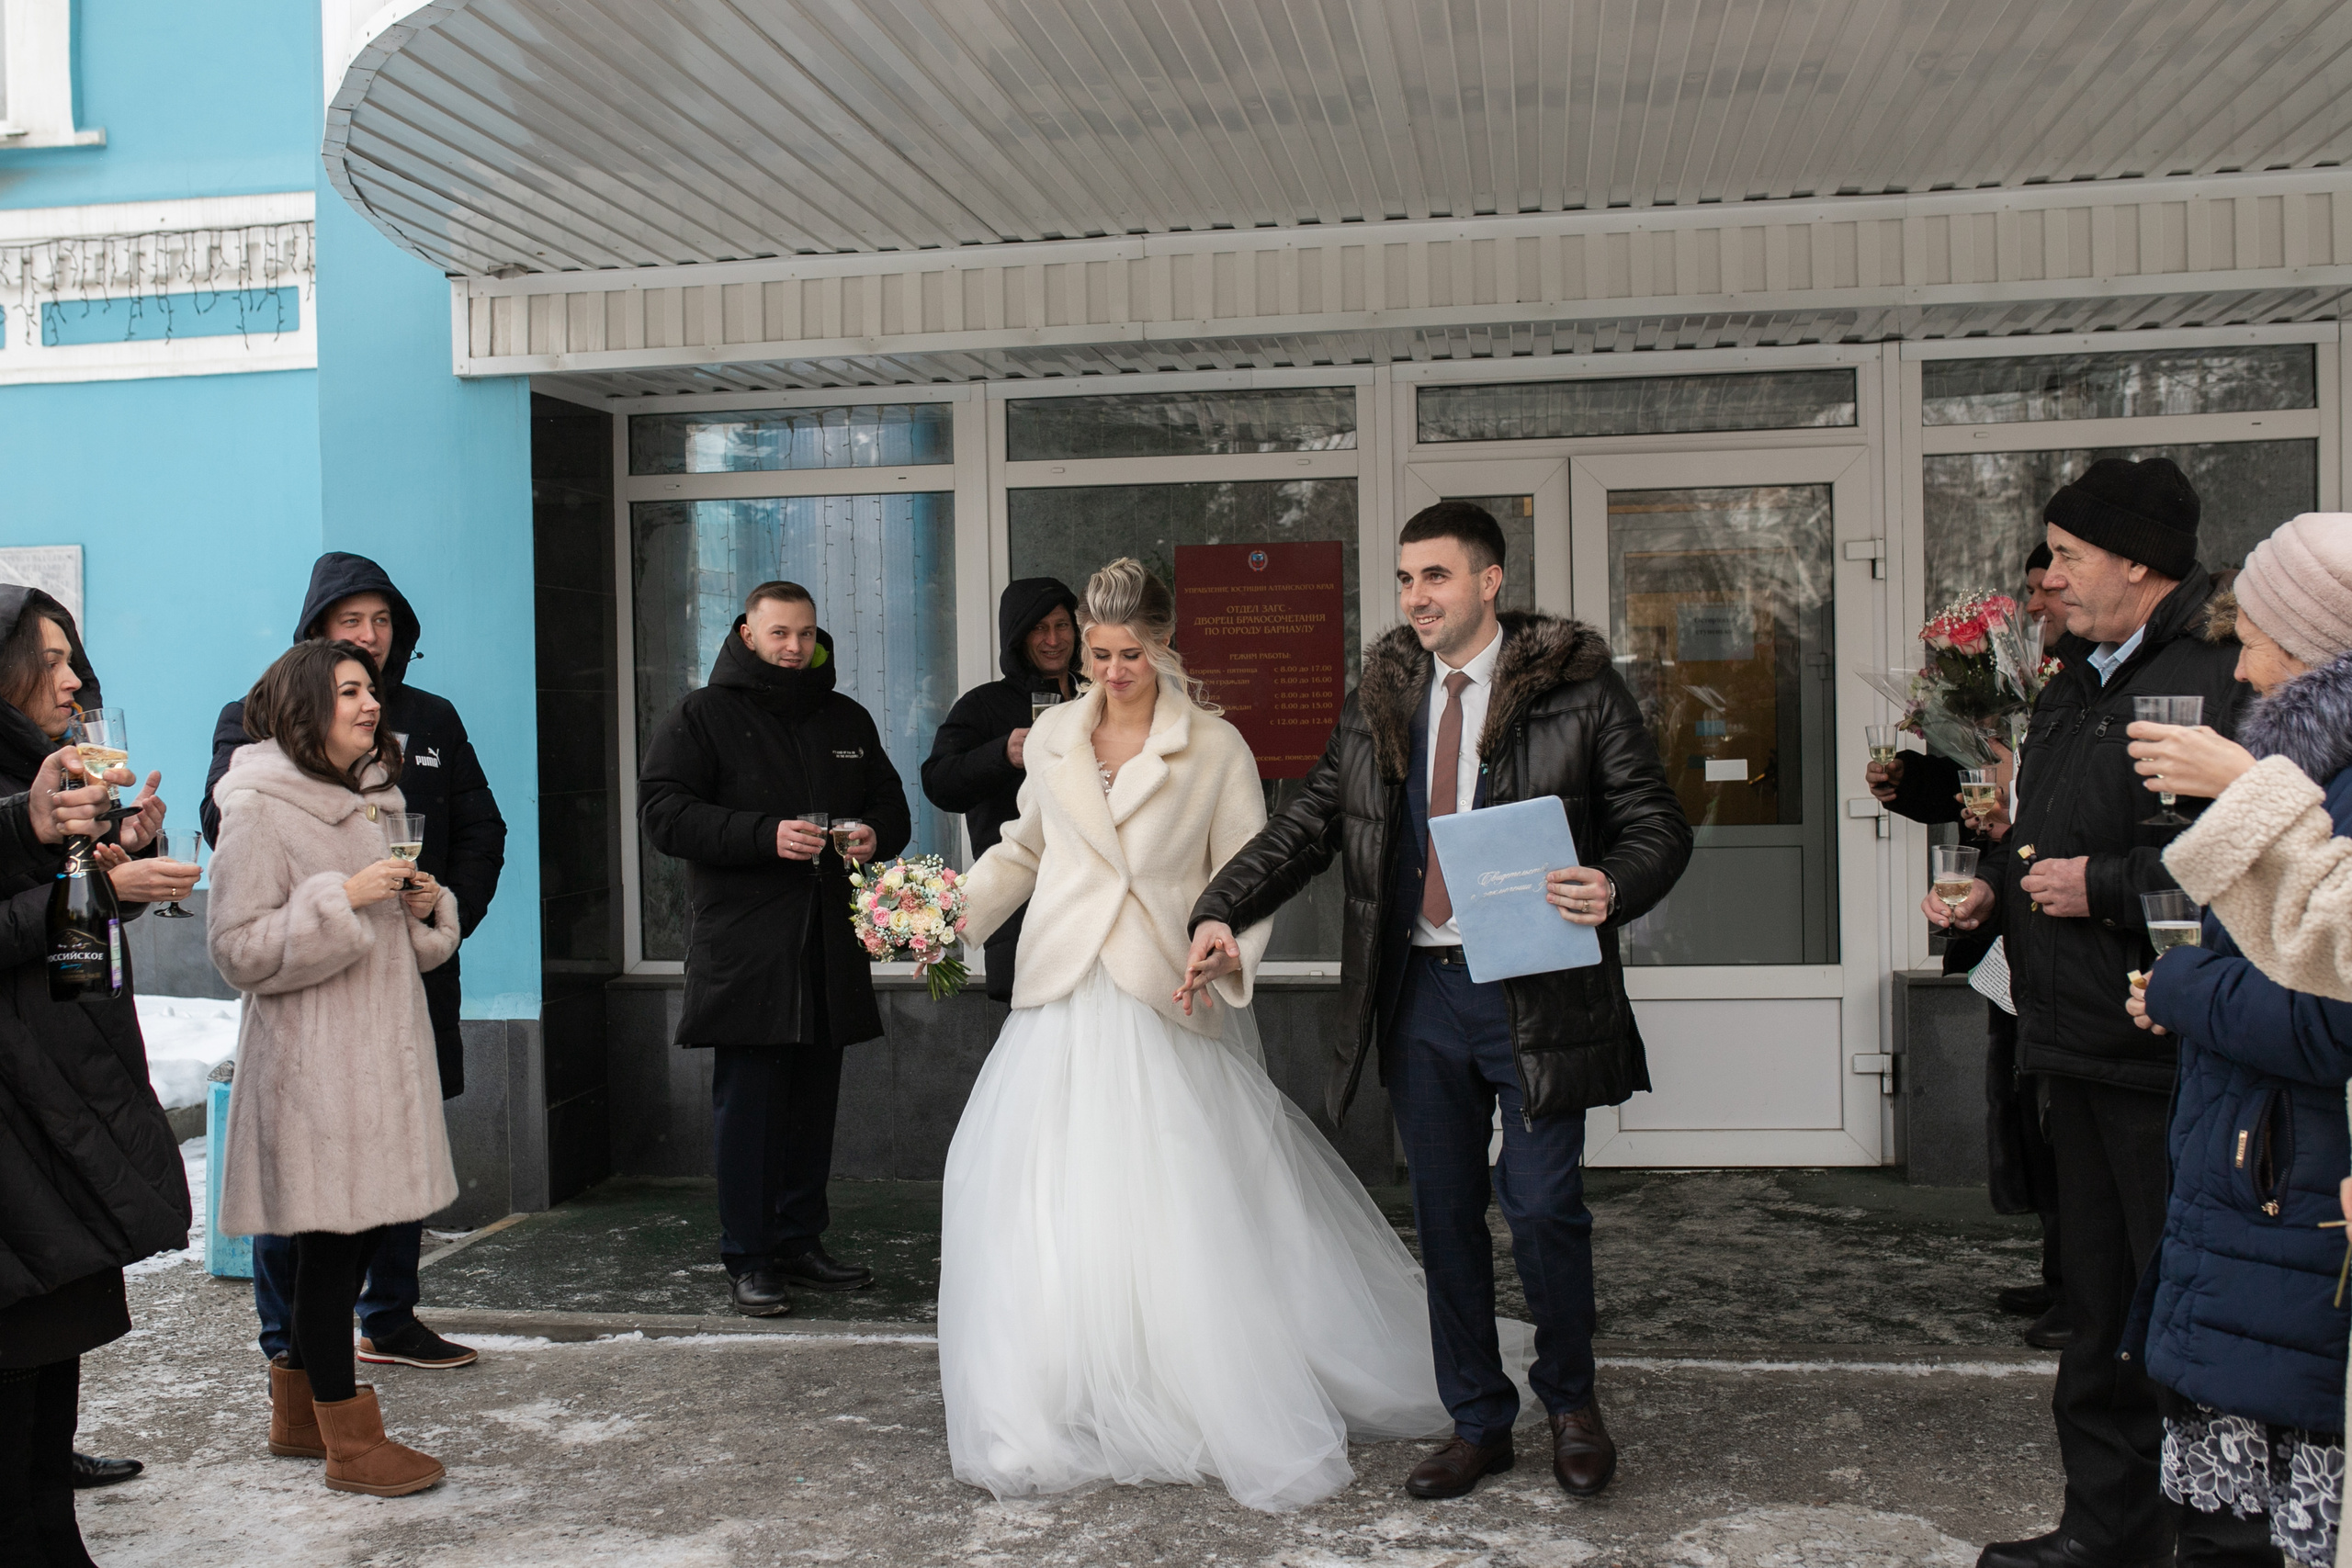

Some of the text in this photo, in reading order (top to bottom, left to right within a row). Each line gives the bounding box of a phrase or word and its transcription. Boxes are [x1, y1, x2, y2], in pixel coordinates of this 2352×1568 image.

[1227, 604, 1259, 614] ОТДЕЛ
[1261, 604, 1286, 613] ЗАГС
[1193, 614, 1326, 626] ДВОРЕЦ БРАКОСОЧЕТАНИЯ
[1204, 625, 1315, 636] ПО ГОРОДУ БАРНАУЛУ
[415, 755, 439, 768] PUMA
